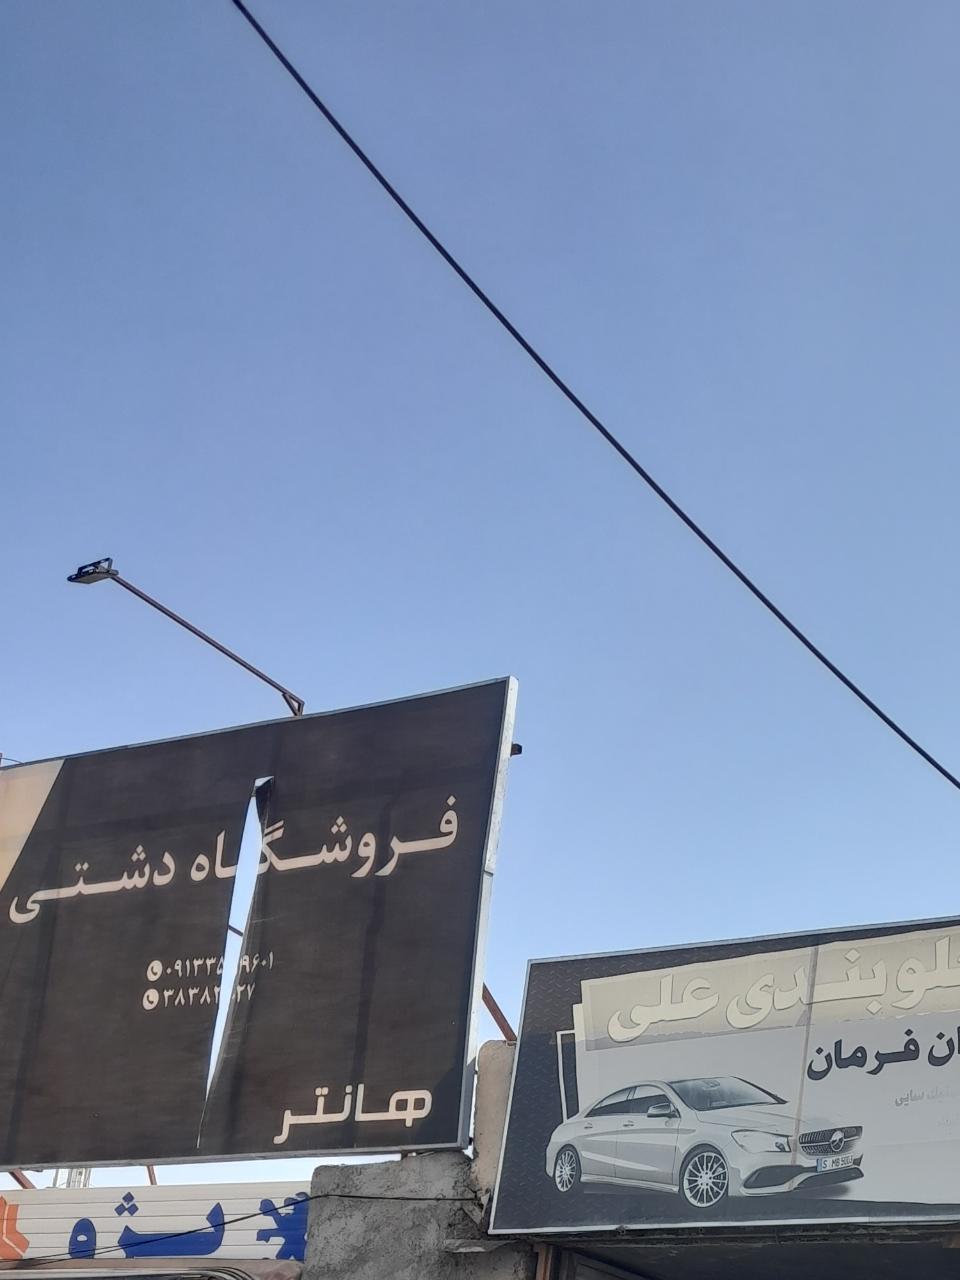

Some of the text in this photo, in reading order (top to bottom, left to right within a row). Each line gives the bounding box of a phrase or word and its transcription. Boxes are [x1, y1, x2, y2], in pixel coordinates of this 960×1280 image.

[8, 795, 459, 924] فروشگاه دشتی
[606, 973, 720, 1043] علی
[806, 1028, 920, 1081] فرمان
[273, 1083, 433, 1145] هانتر
